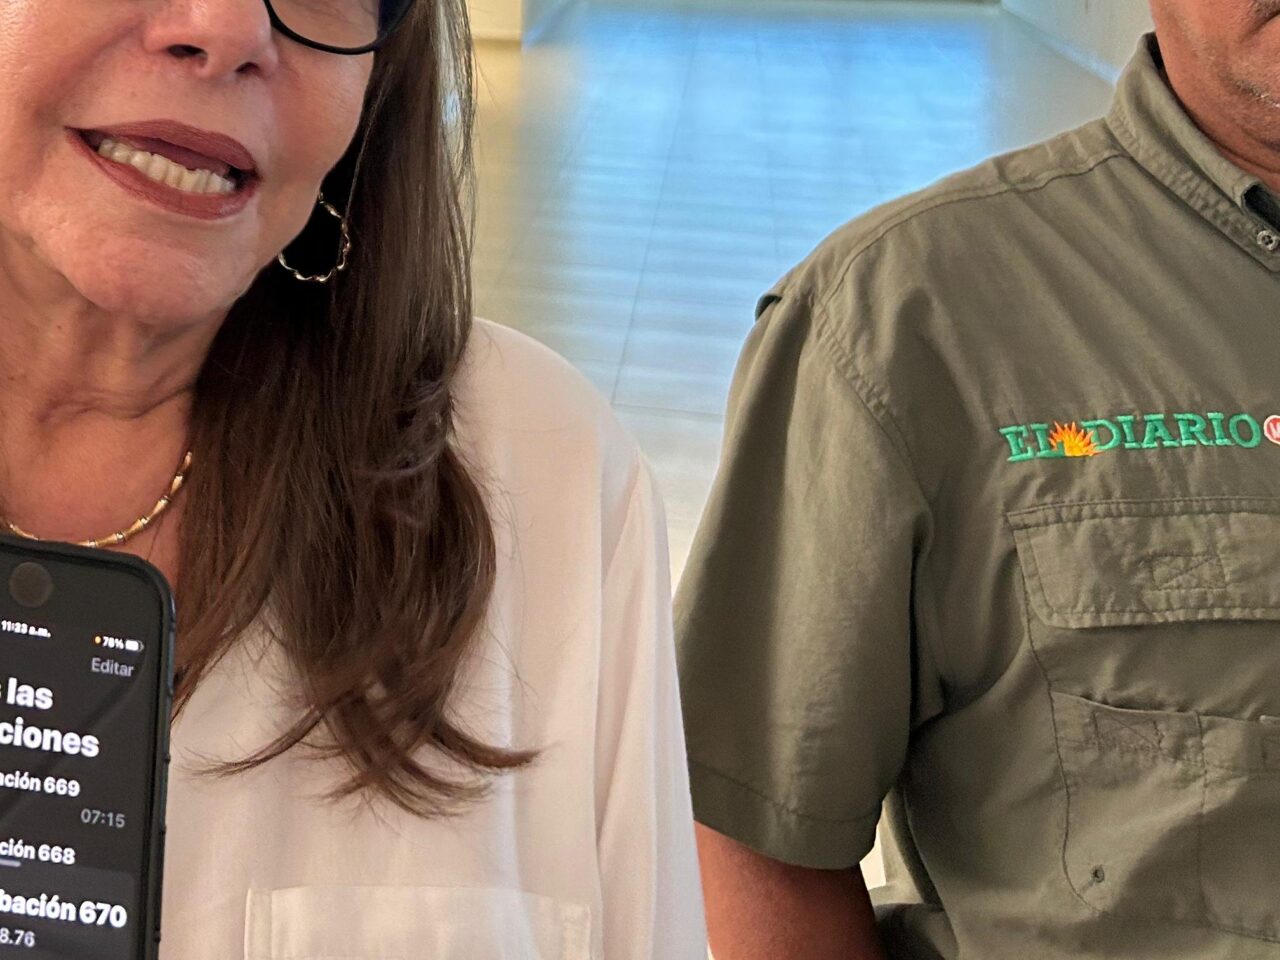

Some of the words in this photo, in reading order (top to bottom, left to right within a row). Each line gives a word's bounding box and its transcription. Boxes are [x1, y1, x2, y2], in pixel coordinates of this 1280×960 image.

[999, 423, 1065, 462] EL
[1081, 412, 1262, 450] DIARIO
[91, 657, 134, 677] Editar
[6, 677, 54, 710] las
[43, 777, 80, 797] 669
[80, 808, 126, 828] 07:15
[38, 844, 76, 865] 668
[79, 900, 128, 928] 670
